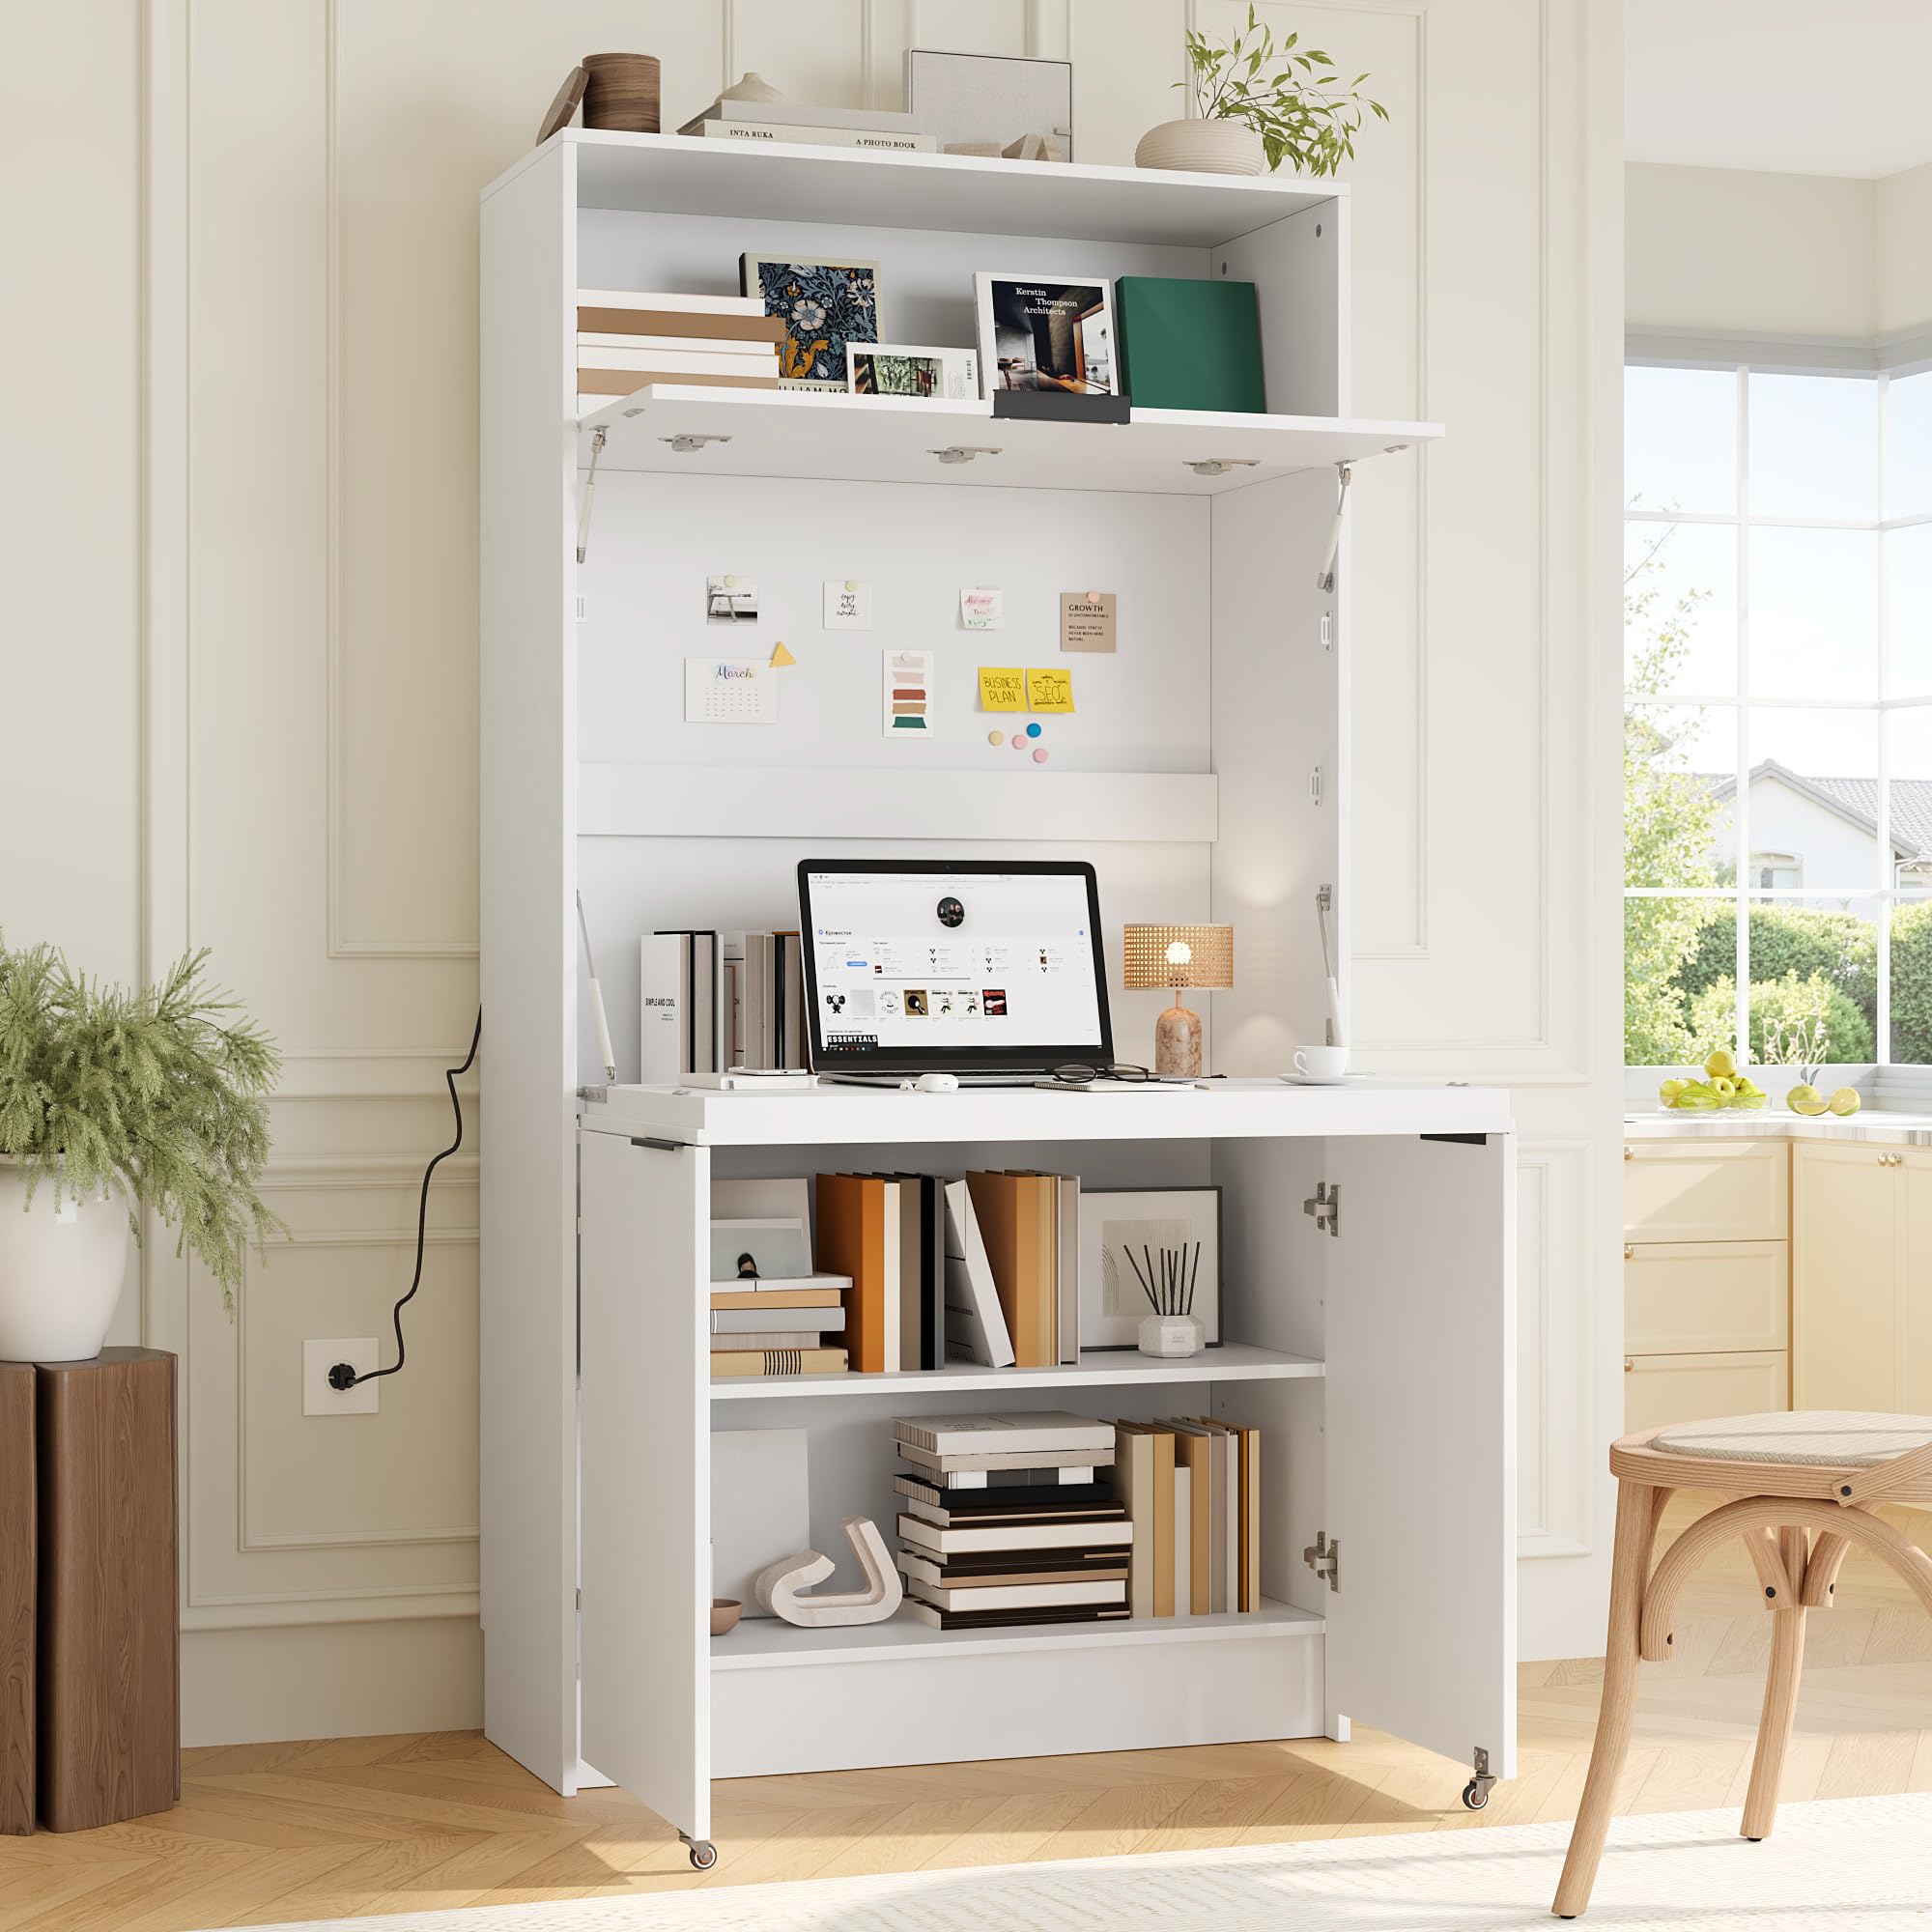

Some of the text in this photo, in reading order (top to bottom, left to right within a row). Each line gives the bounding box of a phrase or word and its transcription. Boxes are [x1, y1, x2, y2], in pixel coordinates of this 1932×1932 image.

[752, 130, 774, 139] RUKA
[864, 139, 892, 148] PHOTO
[1036, 298, 1078, 307] Thompson
[1024, 306, 1065, 315] Architects
[1068, 604, 1103, 612] GROWTH
[715, 664, 753, 679] March
[982, 676, 1021, 690] BUSINESS
[988, 690, 1016, 703] PLAN
[1036, 685, 1061, 701] SEO
[645, 997, 658, 1006] SIMPLE
[666, 998, 675, 1007] COOL
